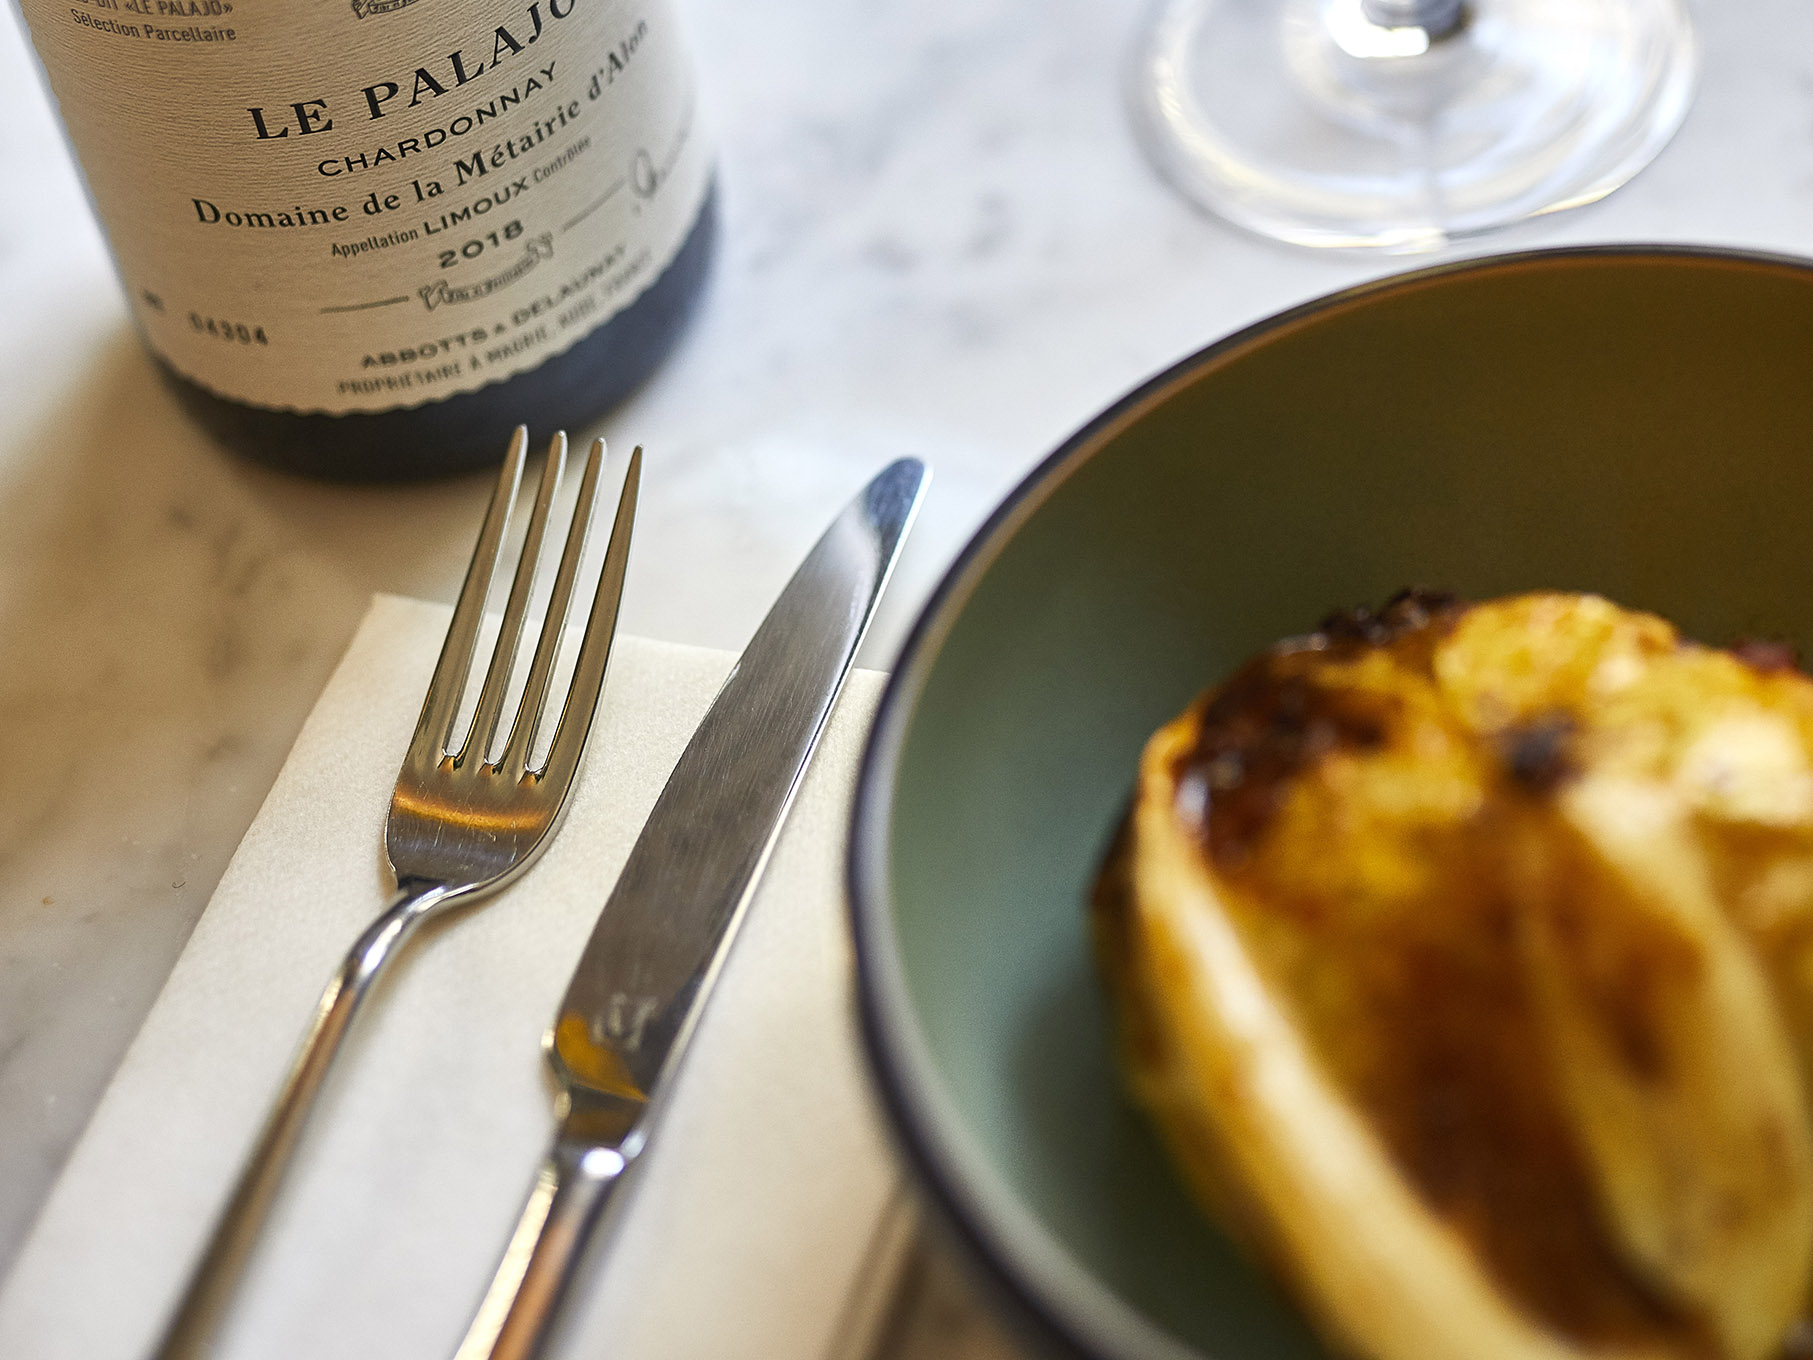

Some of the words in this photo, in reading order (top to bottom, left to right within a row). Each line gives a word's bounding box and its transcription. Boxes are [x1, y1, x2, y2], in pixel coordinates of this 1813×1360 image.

[71, 8, 140, 38] Sélection
[144, 24, 237, 41] Parcellaire
[247, 99, 333, 140] LE
[318, 61, 556, 176] CHARDONNAY
[191, 198, 349, 228] Domaine
[363, 192, 401, 215] de
[411, 180, 445, 203] la
[453, 101, 581, 186] Métairie
[331, 228, 419, 258] Appellation
[424, 177, 530, 235] LIMOUX
[438, 219, 524, 270] 2018
[361, 327, 488, 368] ABBOTTS
